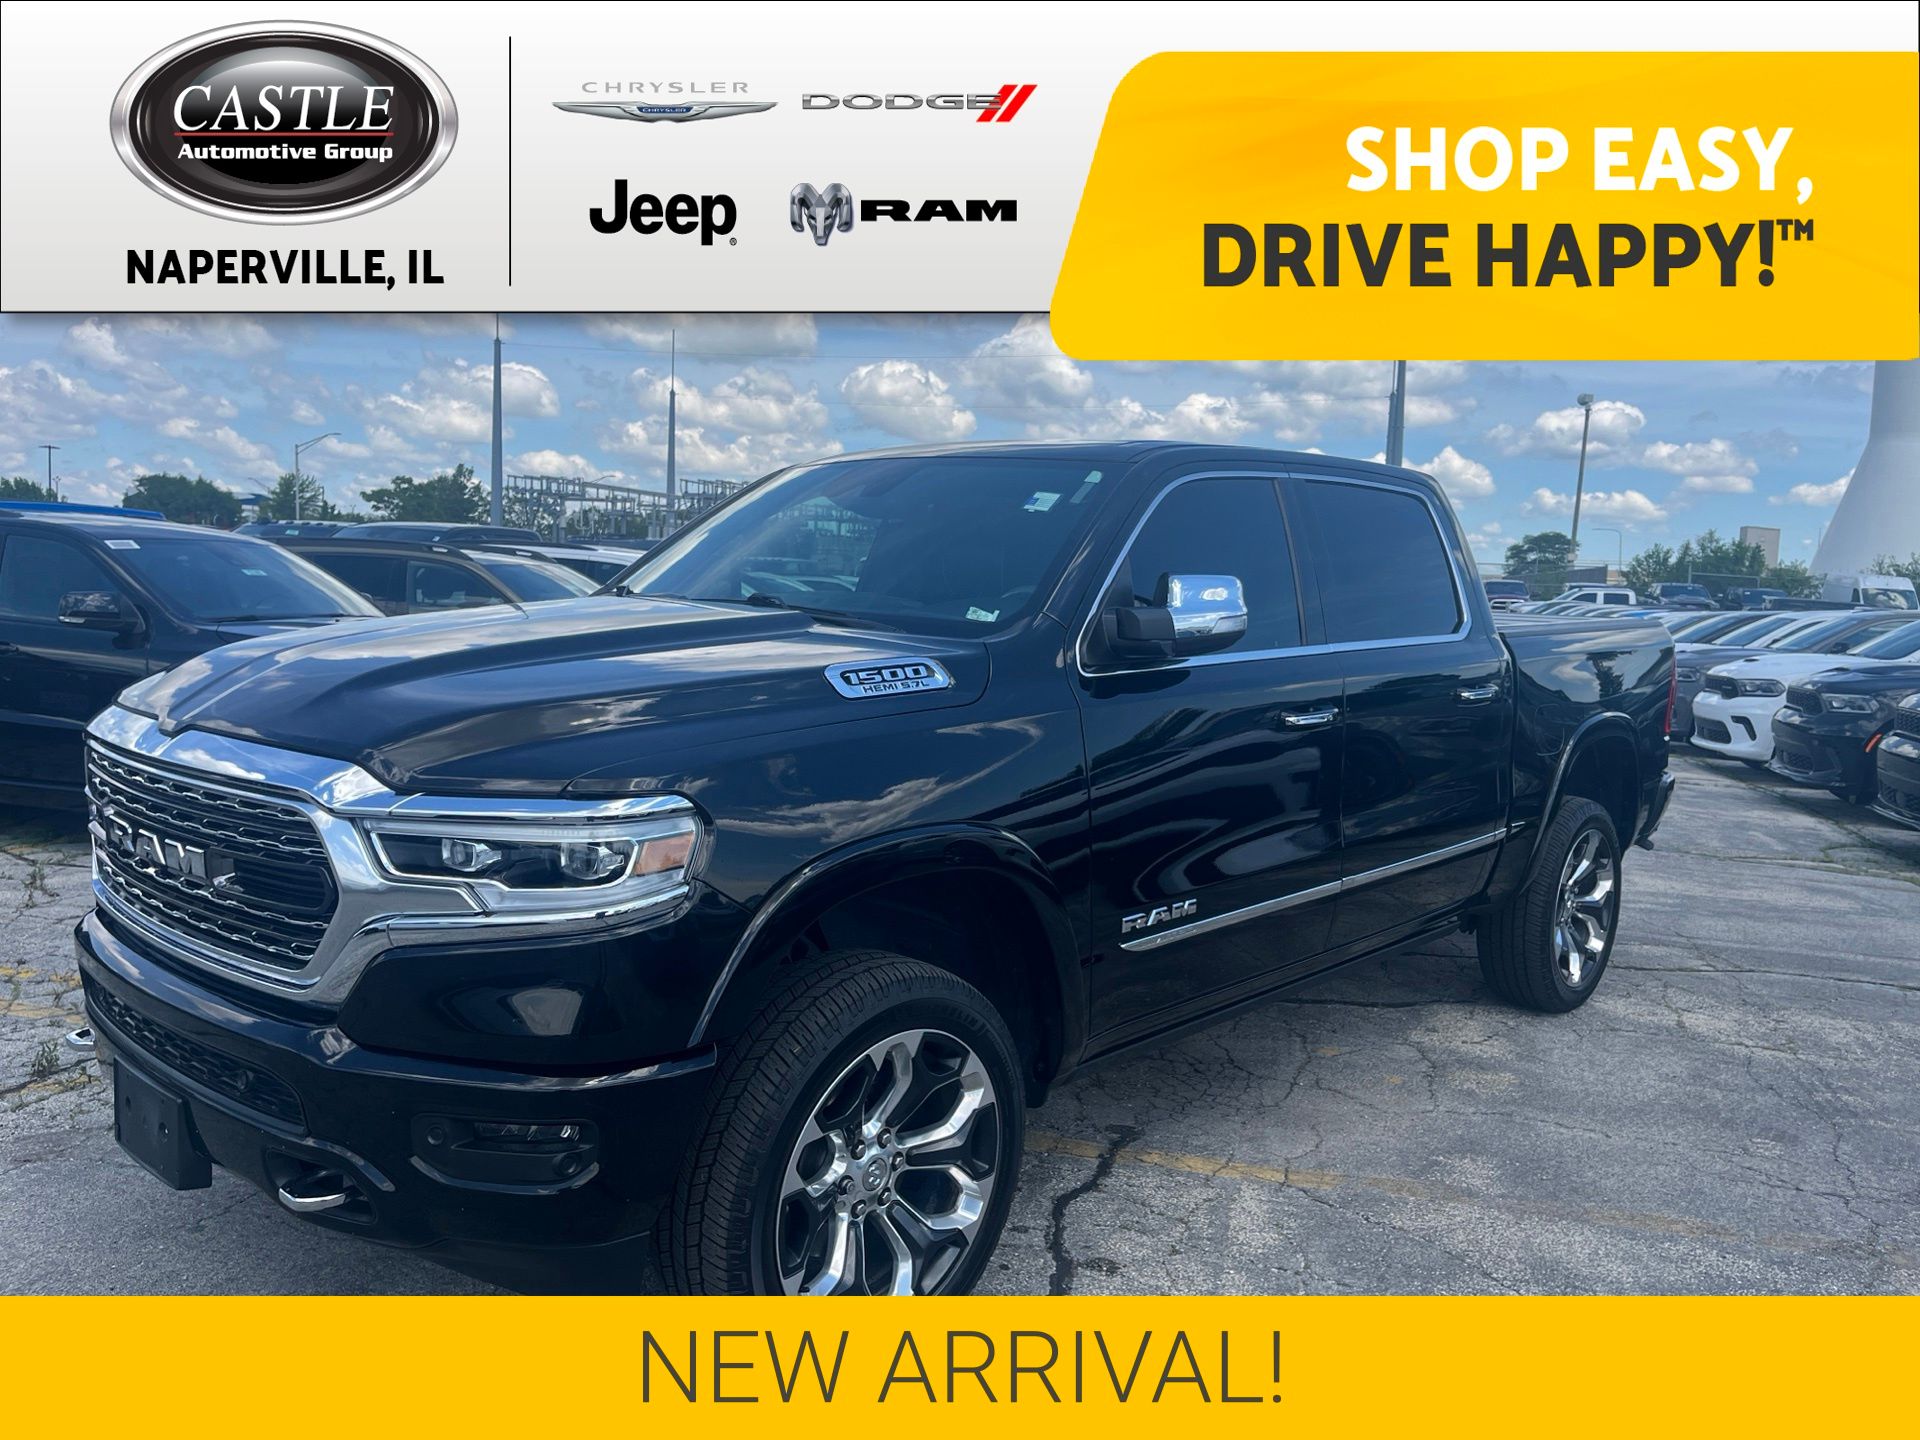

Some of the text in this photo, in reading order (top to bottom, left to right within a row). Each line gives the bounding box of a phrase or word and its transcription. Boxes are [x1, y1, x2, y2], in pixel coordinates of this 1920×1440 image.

[844, 665, 928, 685] 1500
[863, 679, 930, 694] HEMI 5.7L
[107, 814, 206, 879] RAM
[1121, 898, 1197, 934] RAM
